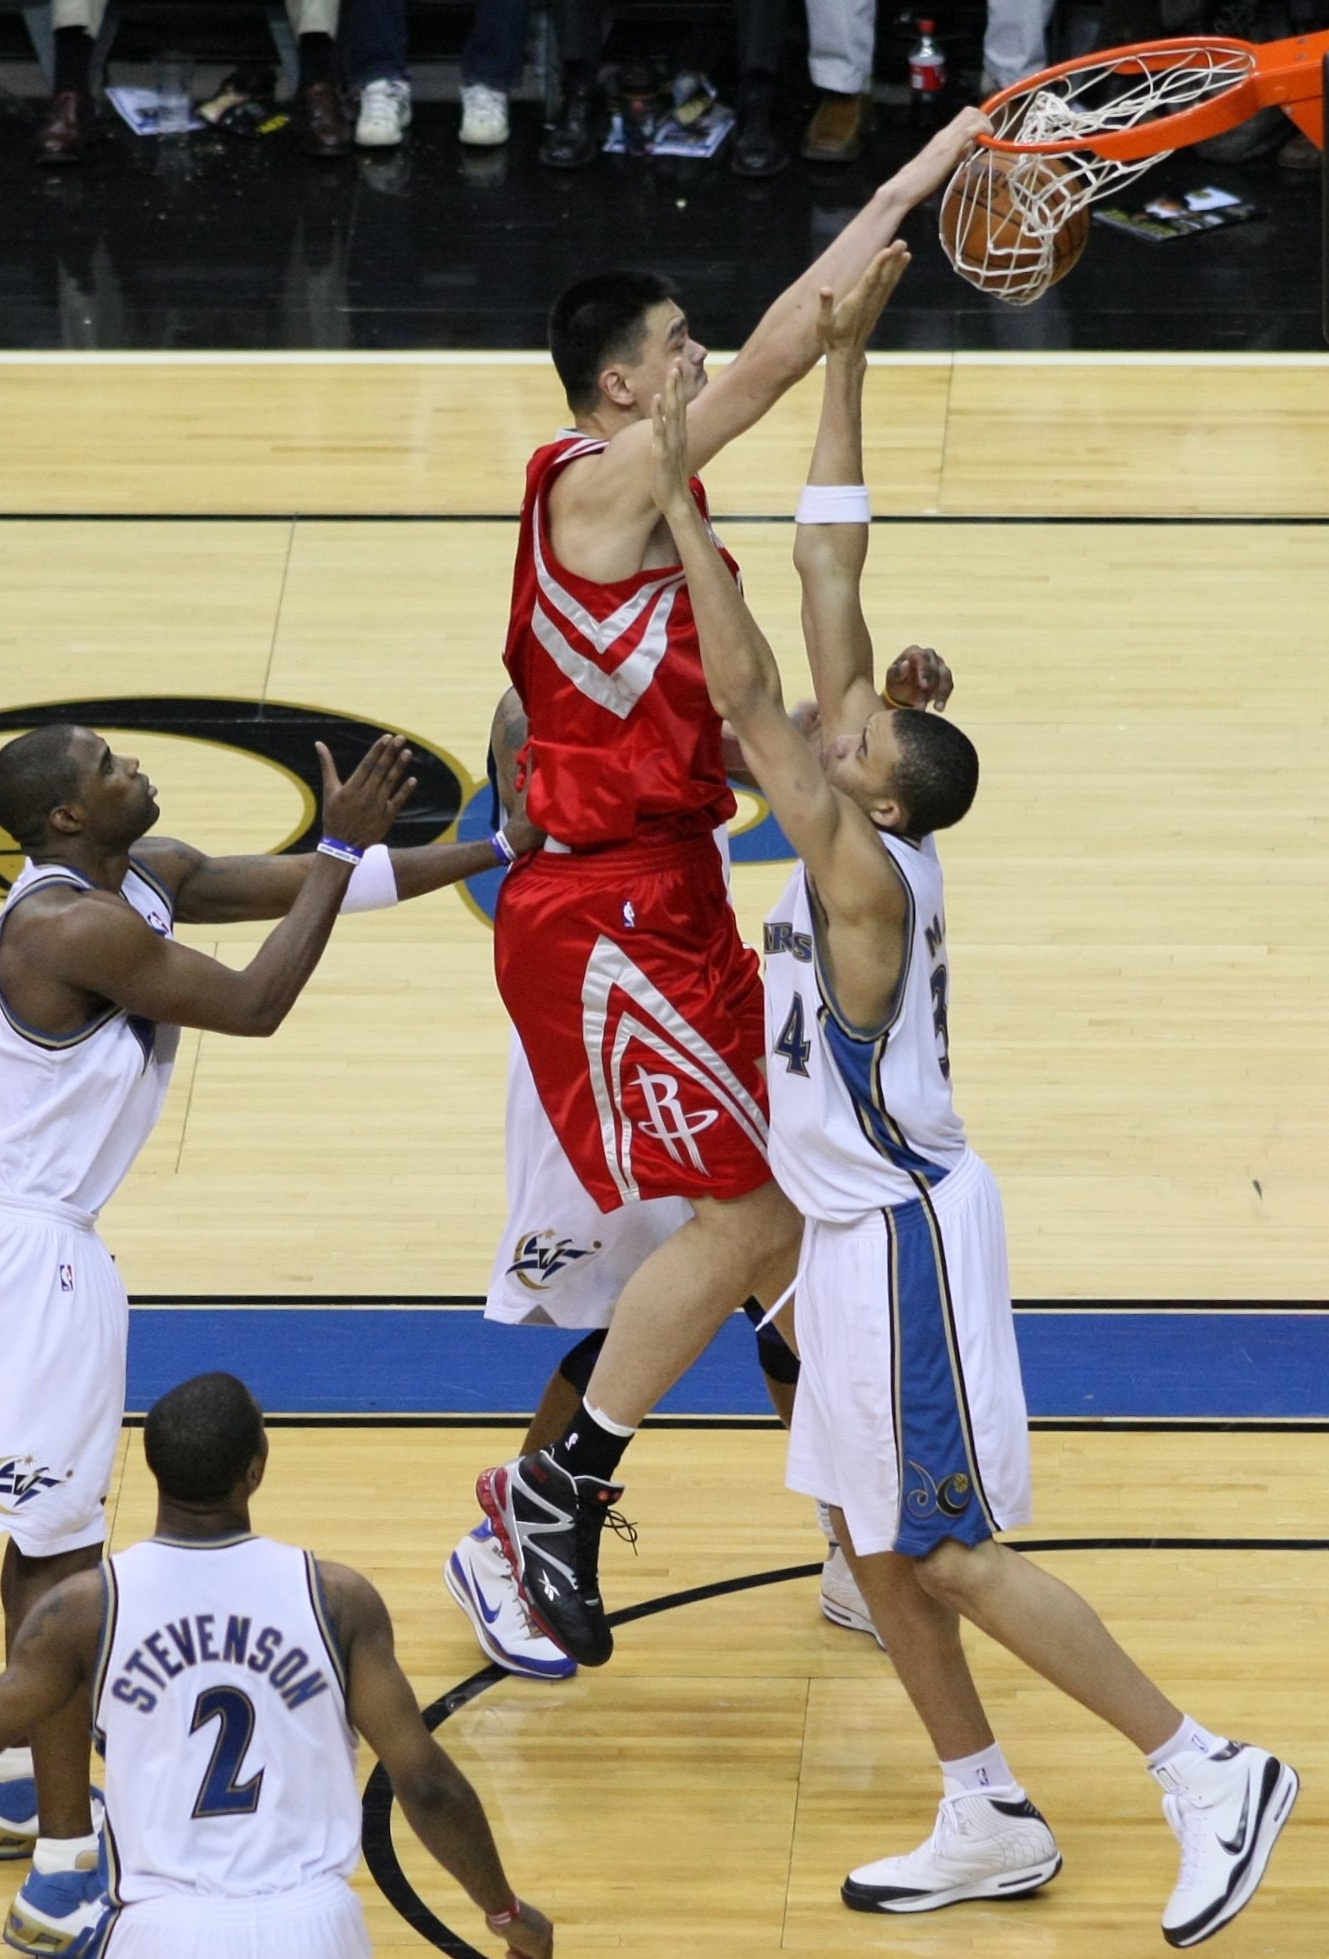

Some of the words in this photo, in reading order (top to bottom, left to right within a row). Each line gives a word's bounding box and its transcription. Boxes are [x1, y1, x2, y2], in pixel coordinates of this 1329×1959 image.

[774, 991, 812, 1079] 4
[111, 1614, 329, 1714] STEVENSON
[188, 1685, 266, 1820] 2
